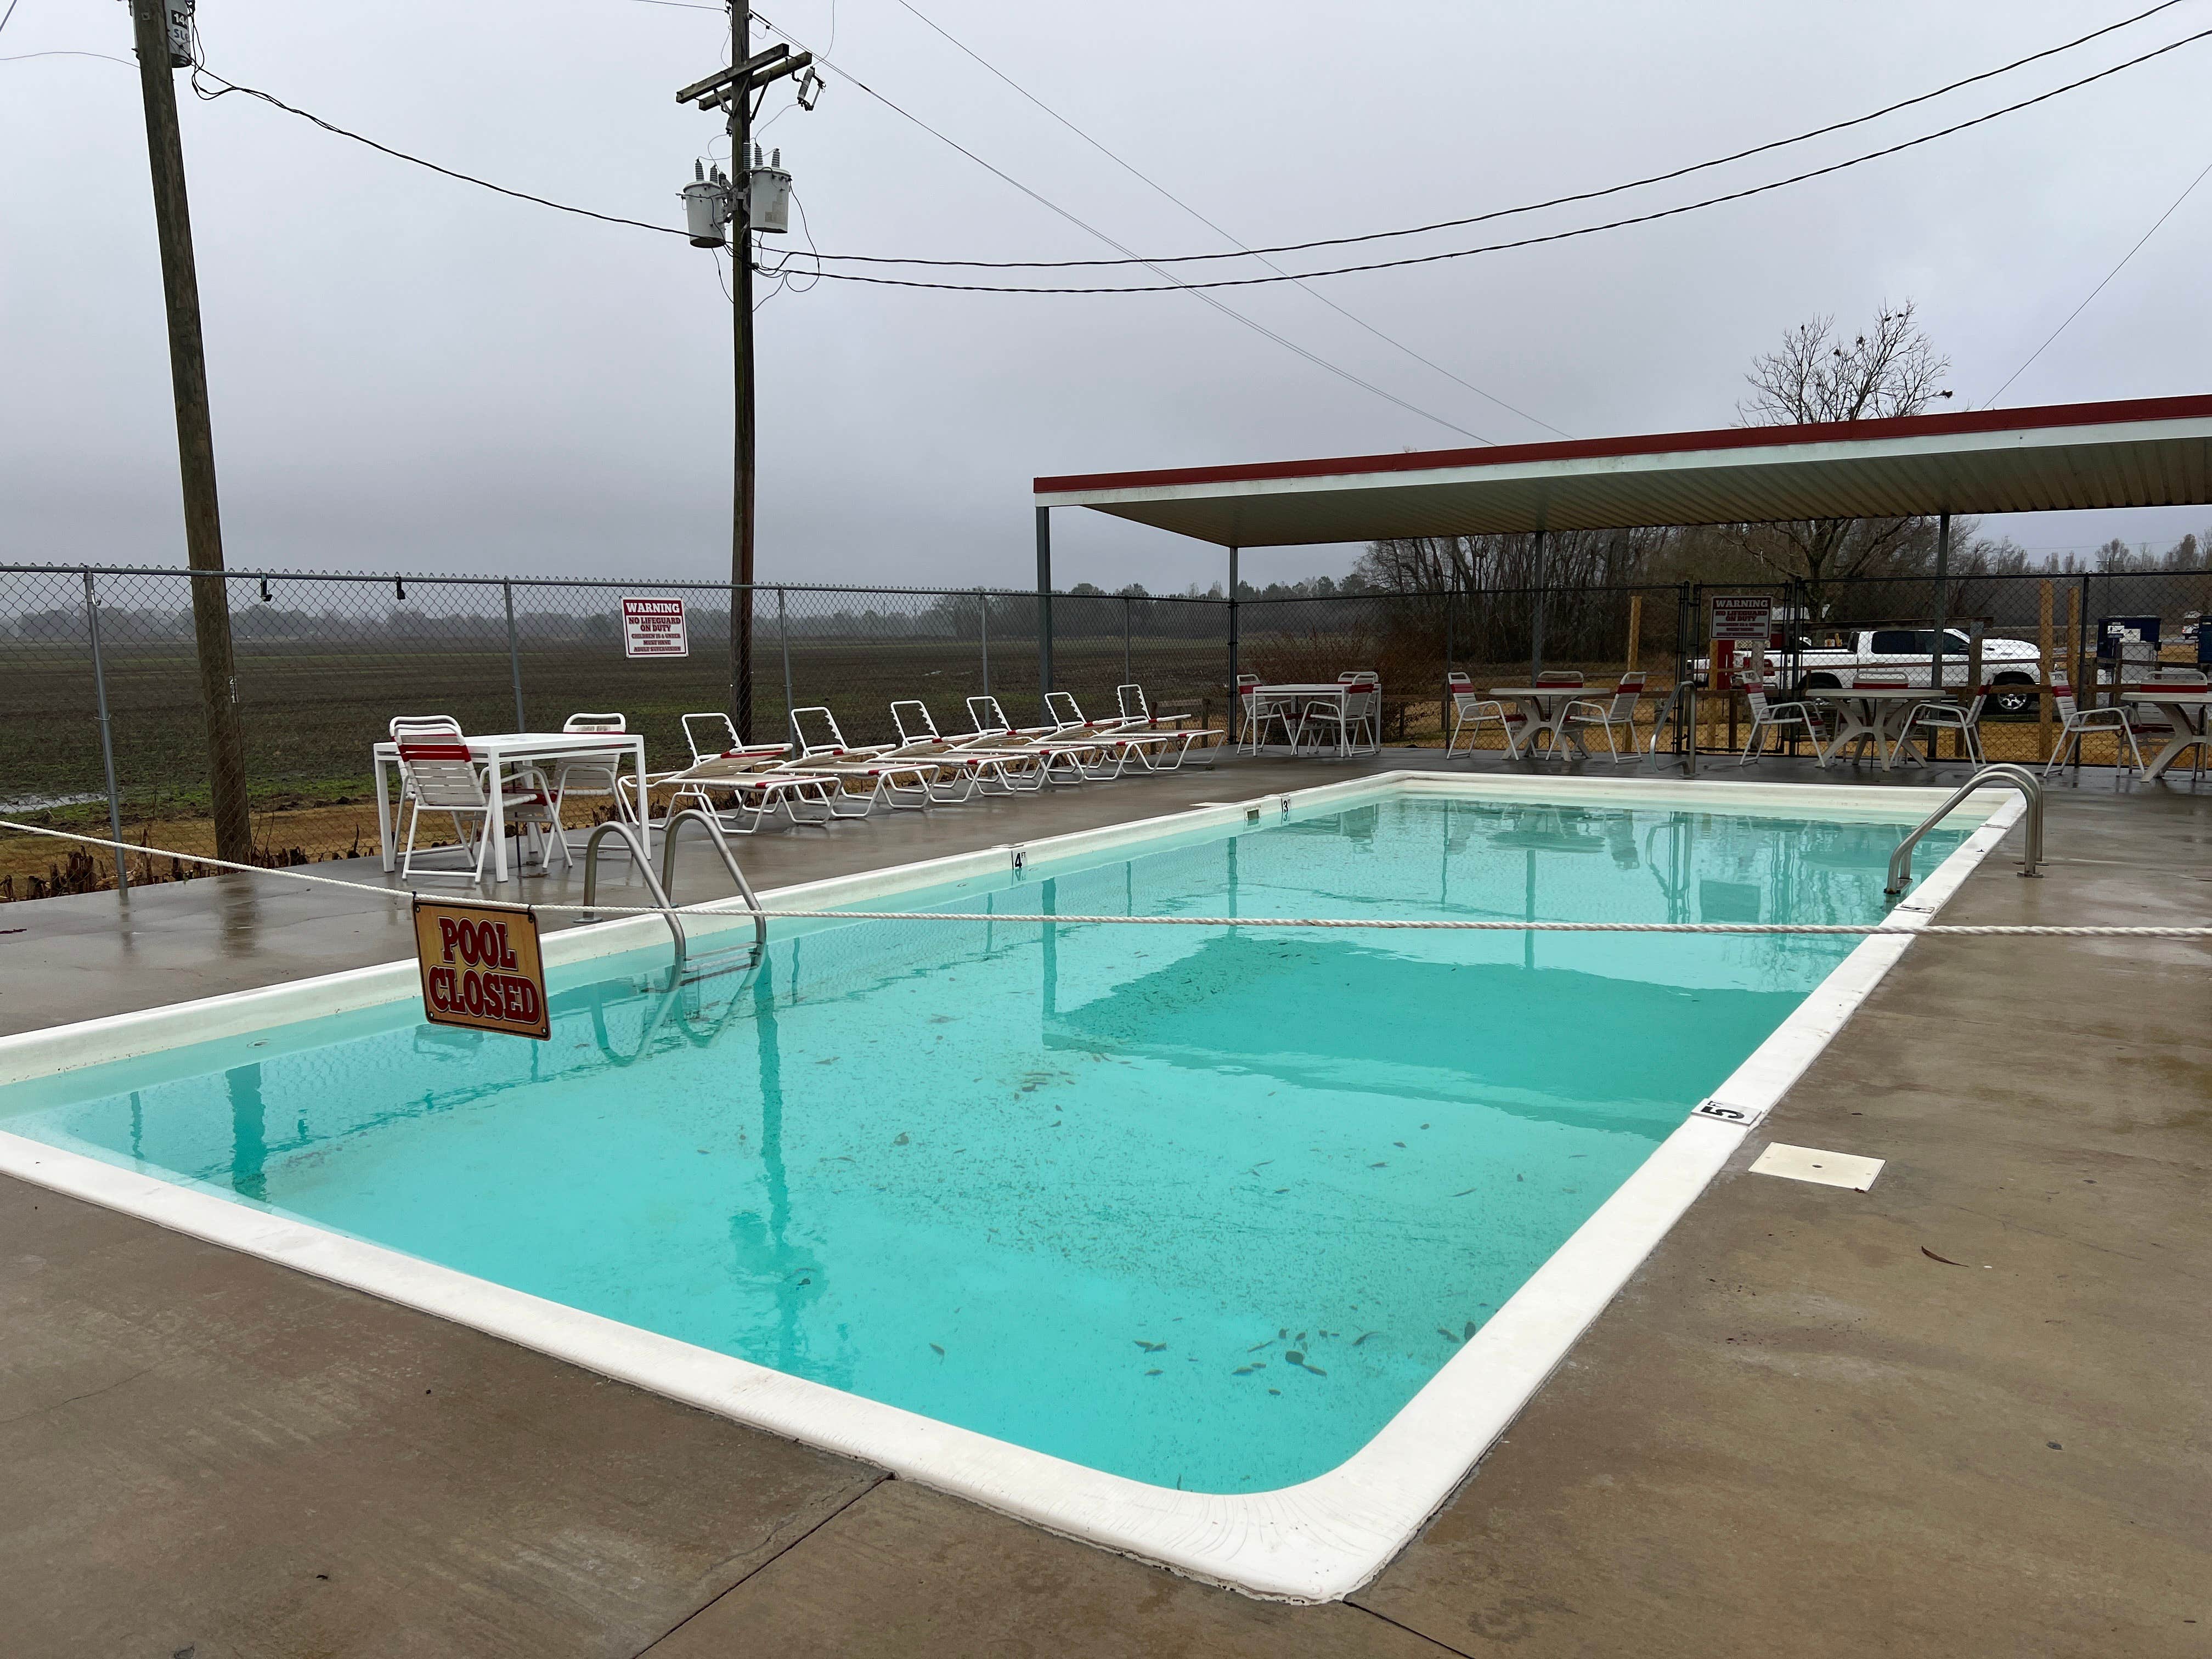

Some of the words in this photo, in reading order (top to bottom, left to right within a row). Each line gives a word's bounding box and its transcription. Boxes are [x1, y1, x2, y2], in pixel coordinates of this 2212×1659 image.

[626, 602, 680, 613] WARNING
[1283, 800, 1288, 812] 3
[1014, 853, 1022, 868] 4
[438, 916, 518, 972] POOL
[428, 965, 541, 1025] CLOSED
[1701, 1105, 1745, 1119] 5
